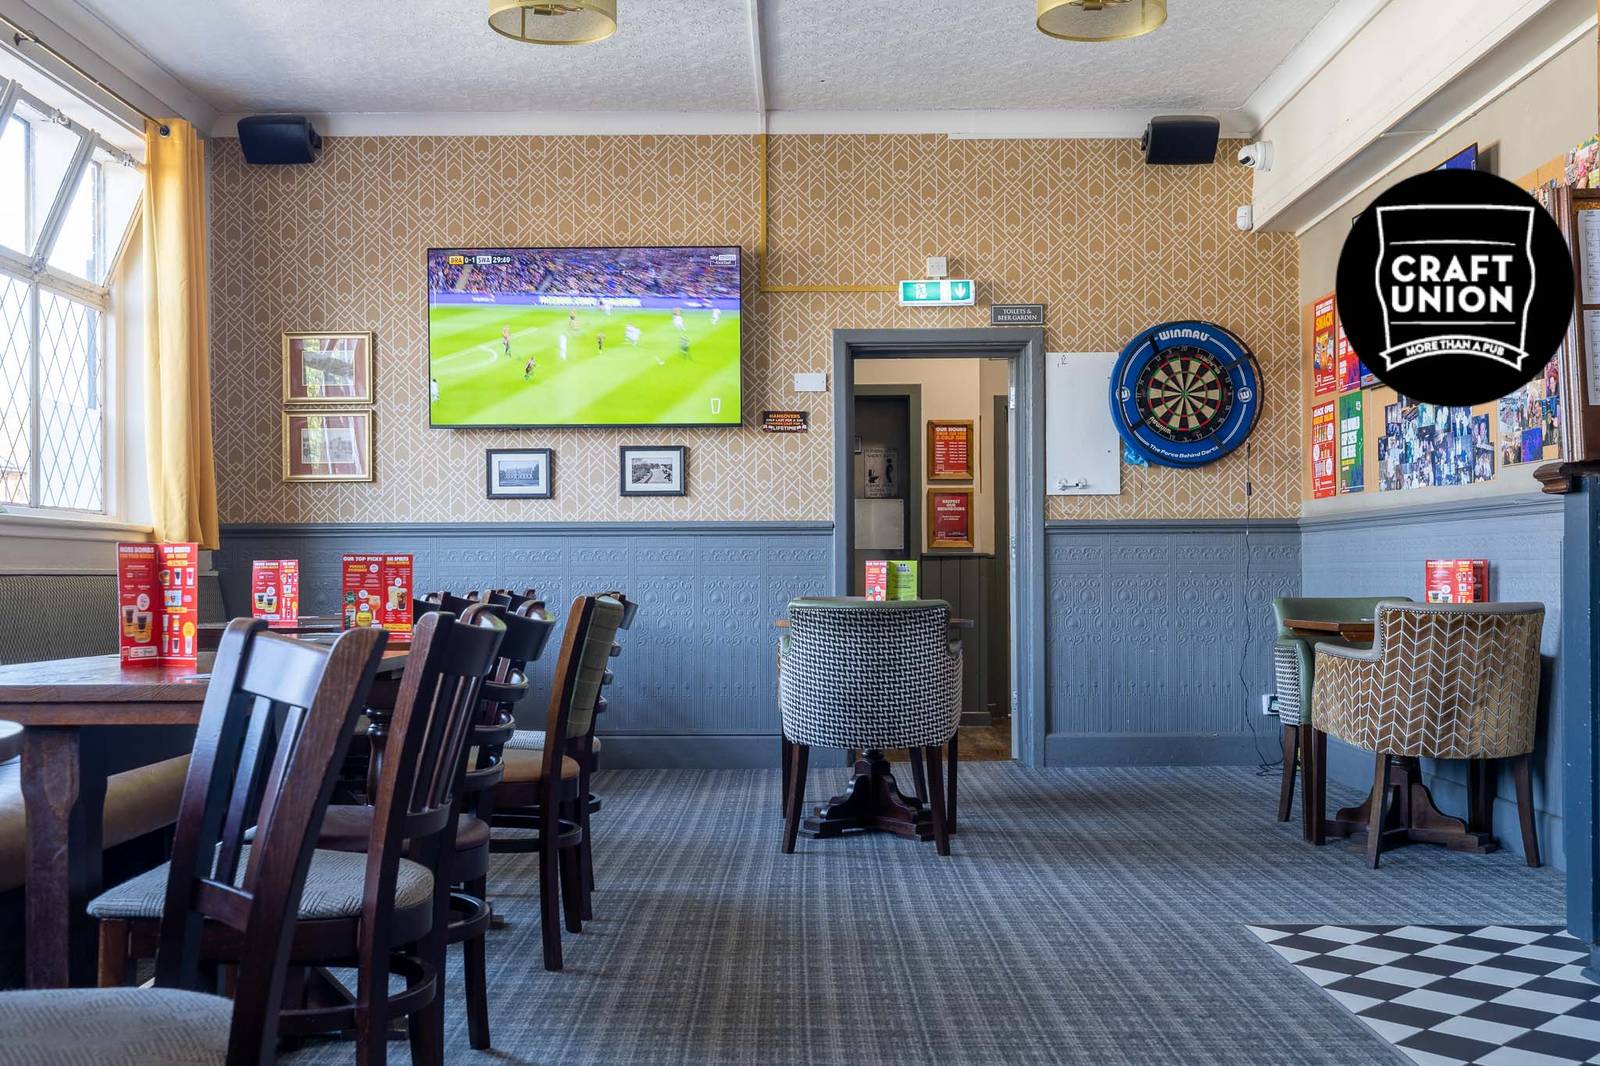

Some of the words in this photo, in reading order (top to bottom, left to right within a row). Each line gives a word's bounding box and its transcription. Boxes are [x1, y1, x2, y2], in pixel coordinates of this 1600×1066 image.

[1158, 328, 1209, 341] WINMAU
[1150, 444, 1160, 453] The
[1160, 450, 1178, 458] Force
